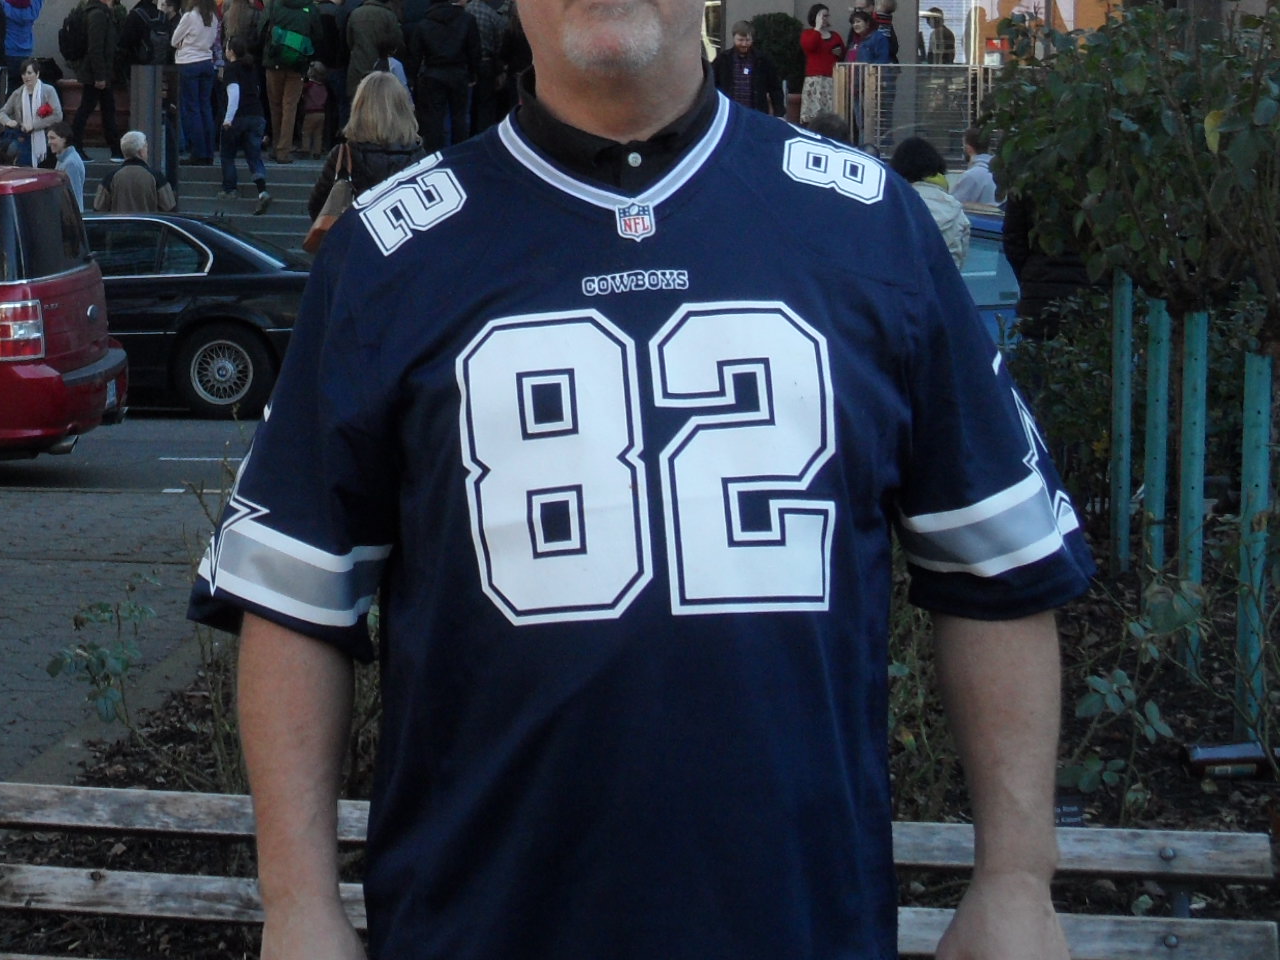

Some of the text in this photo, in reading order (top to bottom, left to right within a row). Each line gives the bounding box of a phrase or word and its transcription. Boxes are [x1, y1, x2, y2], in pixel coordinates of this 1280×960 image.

[622, 216, 650, 234] NFL
[582, 270, 689, 296] COWBOYS
[456, 301, 836, 626] 82
